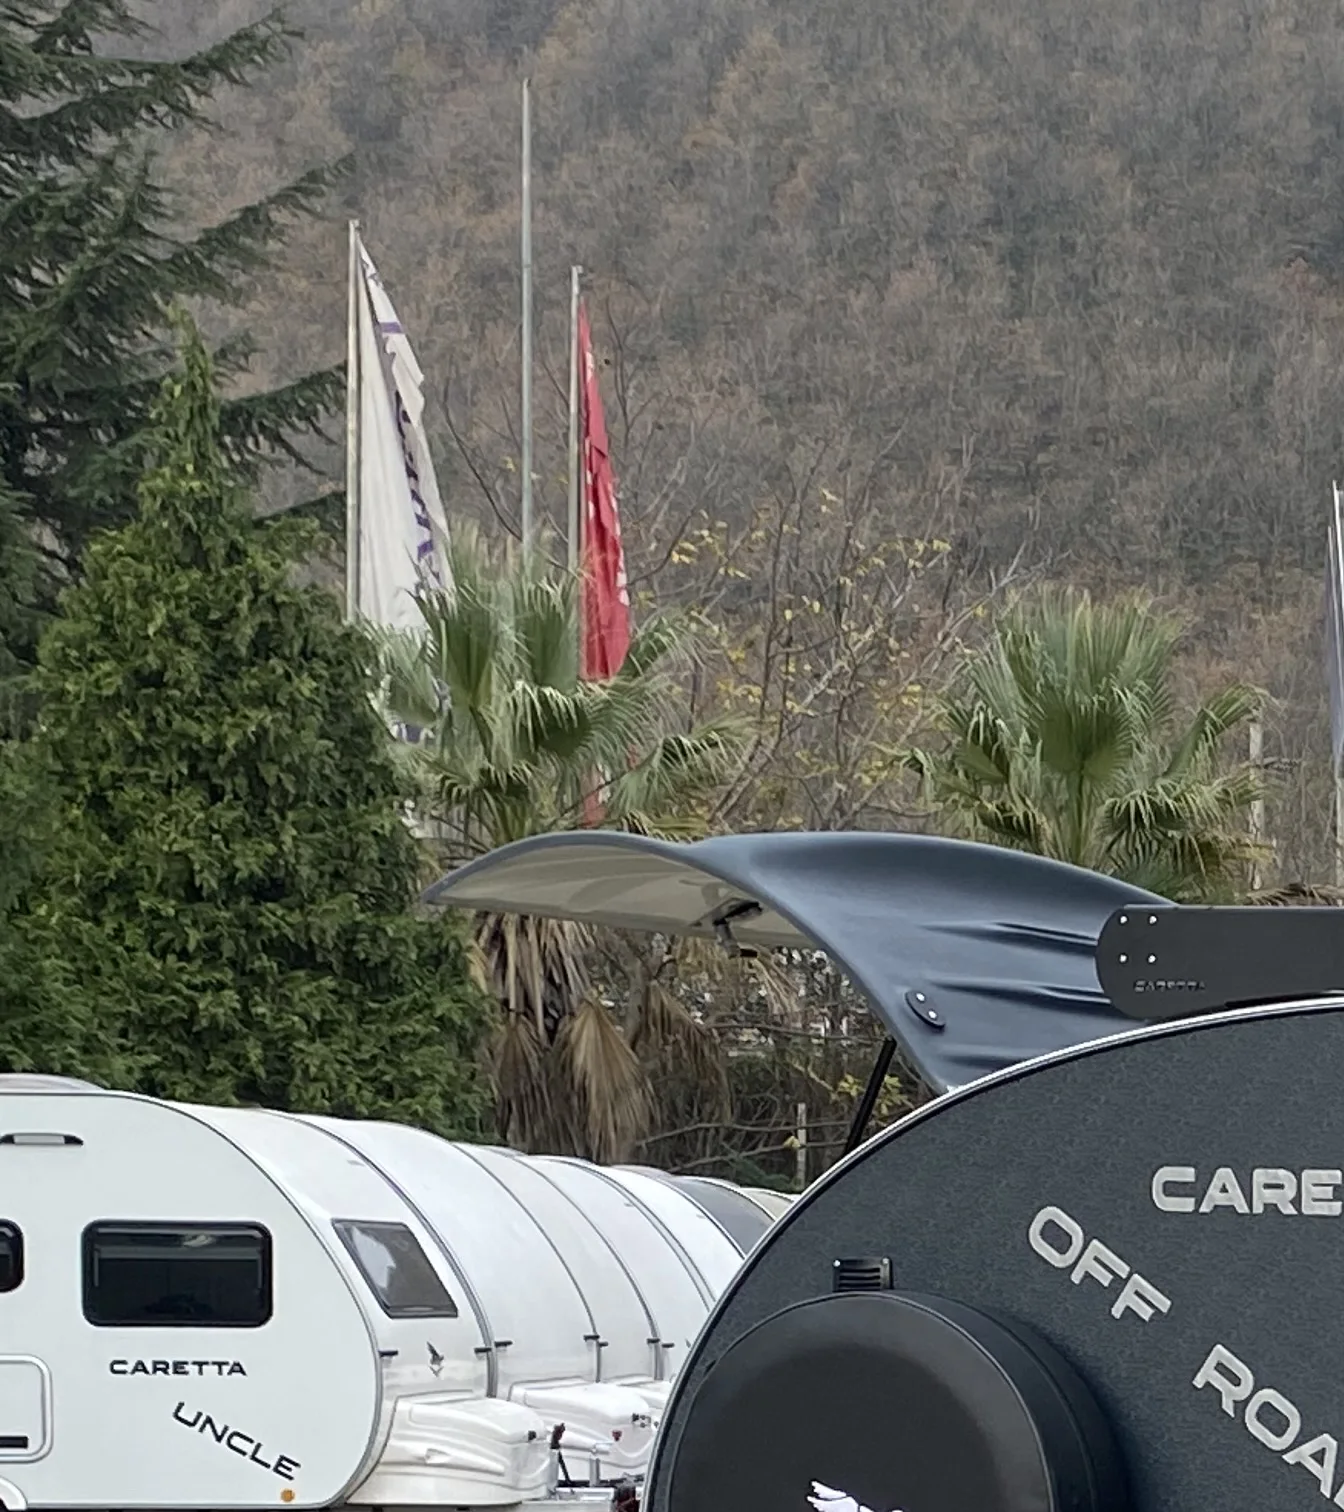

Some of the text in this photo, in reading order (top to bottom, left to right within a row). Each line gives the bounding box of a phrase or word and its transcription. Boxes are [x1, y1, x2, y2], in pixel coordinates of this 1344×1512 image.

[1028, 1206, 1172, 1322] OFF
[109, 1359, 247, 1376] CARETTA
[172, 1401, 301, 1481] UNCLE
